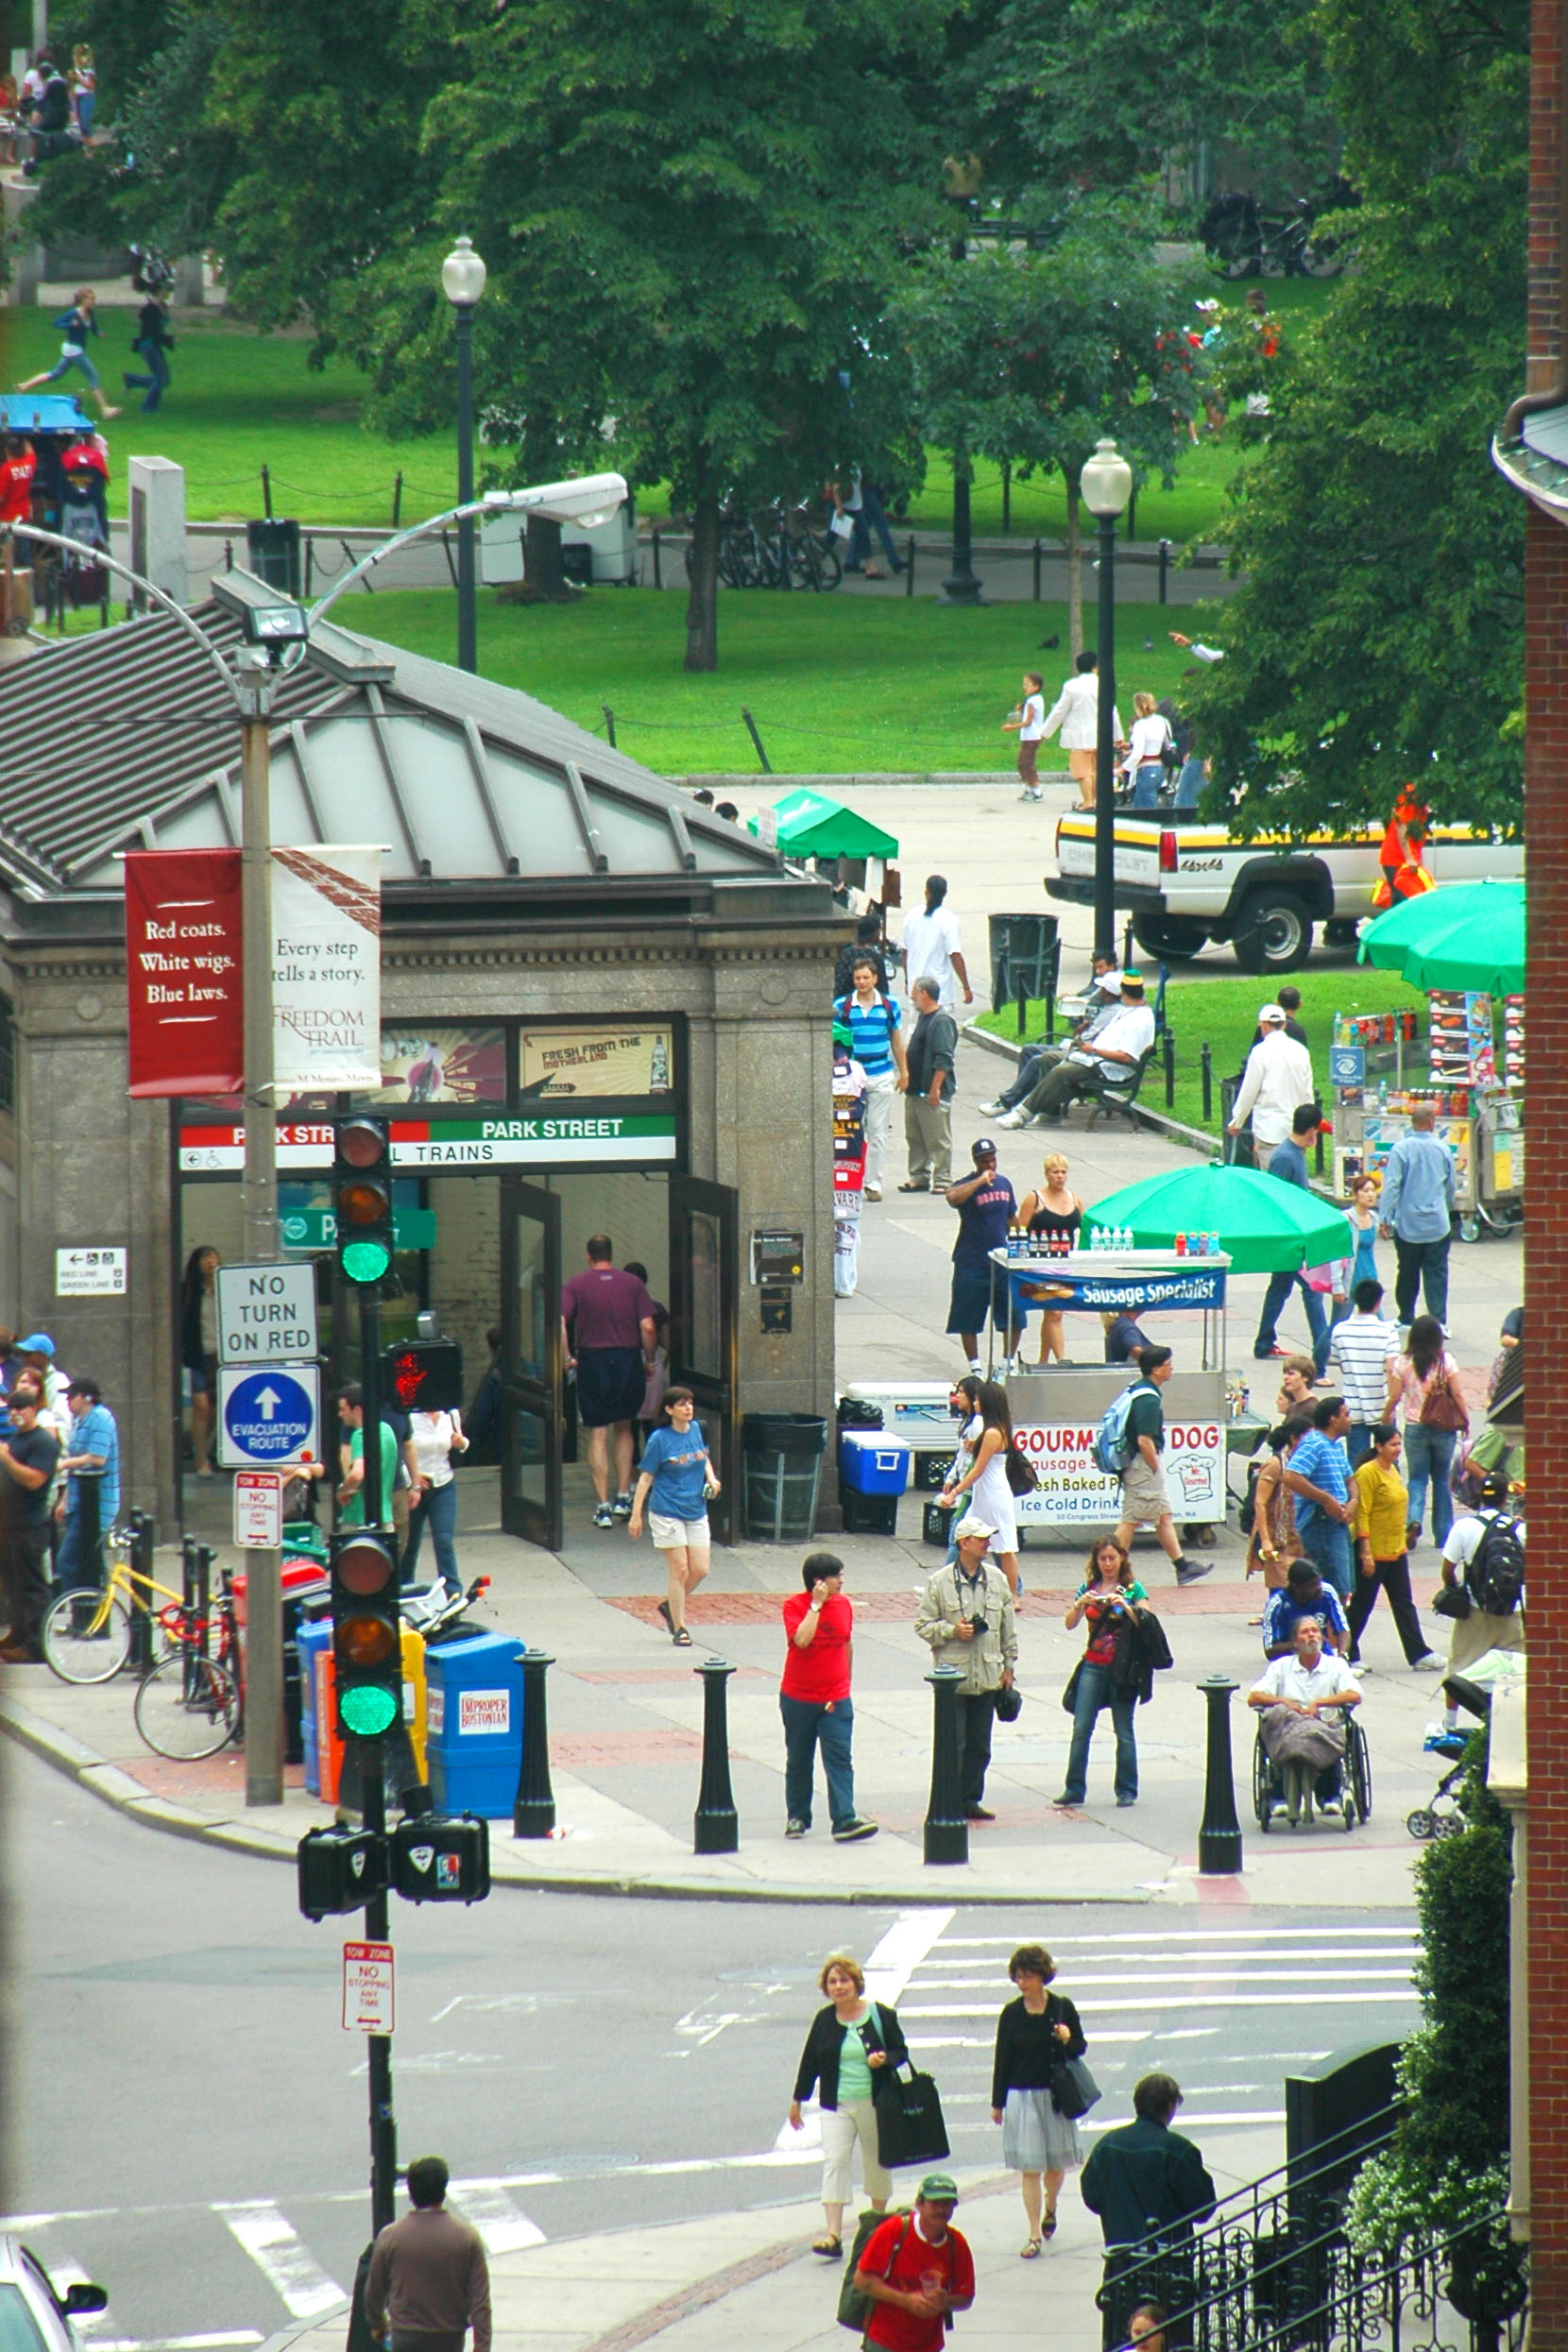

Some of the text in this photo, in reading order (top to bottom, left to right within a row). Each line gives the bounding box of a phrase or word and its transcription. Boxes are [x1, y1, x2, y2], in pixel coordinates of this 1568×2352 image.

[145, 920, 226, 939] Red coats.
[277, 938, 358, 961] Every step
[139, 951, 235, 974] White wigs.
[310, 971, 316, 980] a
[321, 966, 366, 984] story.
[147, 982, 228, 1003] Blue laws.
[303, 1030, 364, 1047] TRAIL
[542, 1036, 641, 1062] FRESH FROM THE
[543, 1052, 607, 1069] MOTHERLAND
[232, 1124, 335, 1145] PK STR
[483, 1118, 623, 1139] PARK STREET
[417, 1144, 494, 1162] TRAINS
[834, 1192, 861, 1212] VARD
[249, 1276, 285, 1296] NO
[1082, 1278, 1217, 1307] Sausage Specialist
[239, 1304, 297, 1323] TURN
[229, 1329, 311, 1351] ON RED
[231, 1423, 307, 1437] EVACUATION
[247, 1437, 291, 1450] ROUTE
[1013, 1425, 1219, 1454] GOURM DOG
[1032, 1460, 1086, 1474] ausage
[238, 1476, 279, 1488] TOW ZONE
[1034, 1478, 1059, 1492] esh
[1063, 1476, 1106, 1491] Baked
[249, 1491, 266, 1503] NO
[1021, 1497, 1120, 1511] Ice Cold Drink
[461, 1697, 507, 1713] IMPROPER
[461, 1712, 507, 1729] BOSTONIAN
[347, 1947, 392, 1960] TOW ZONE
[359, 1966, 379, 1978] NO
[348, 1978, 391, 1989] STOPPING
[361, 1998, 379, 2007] TIME
